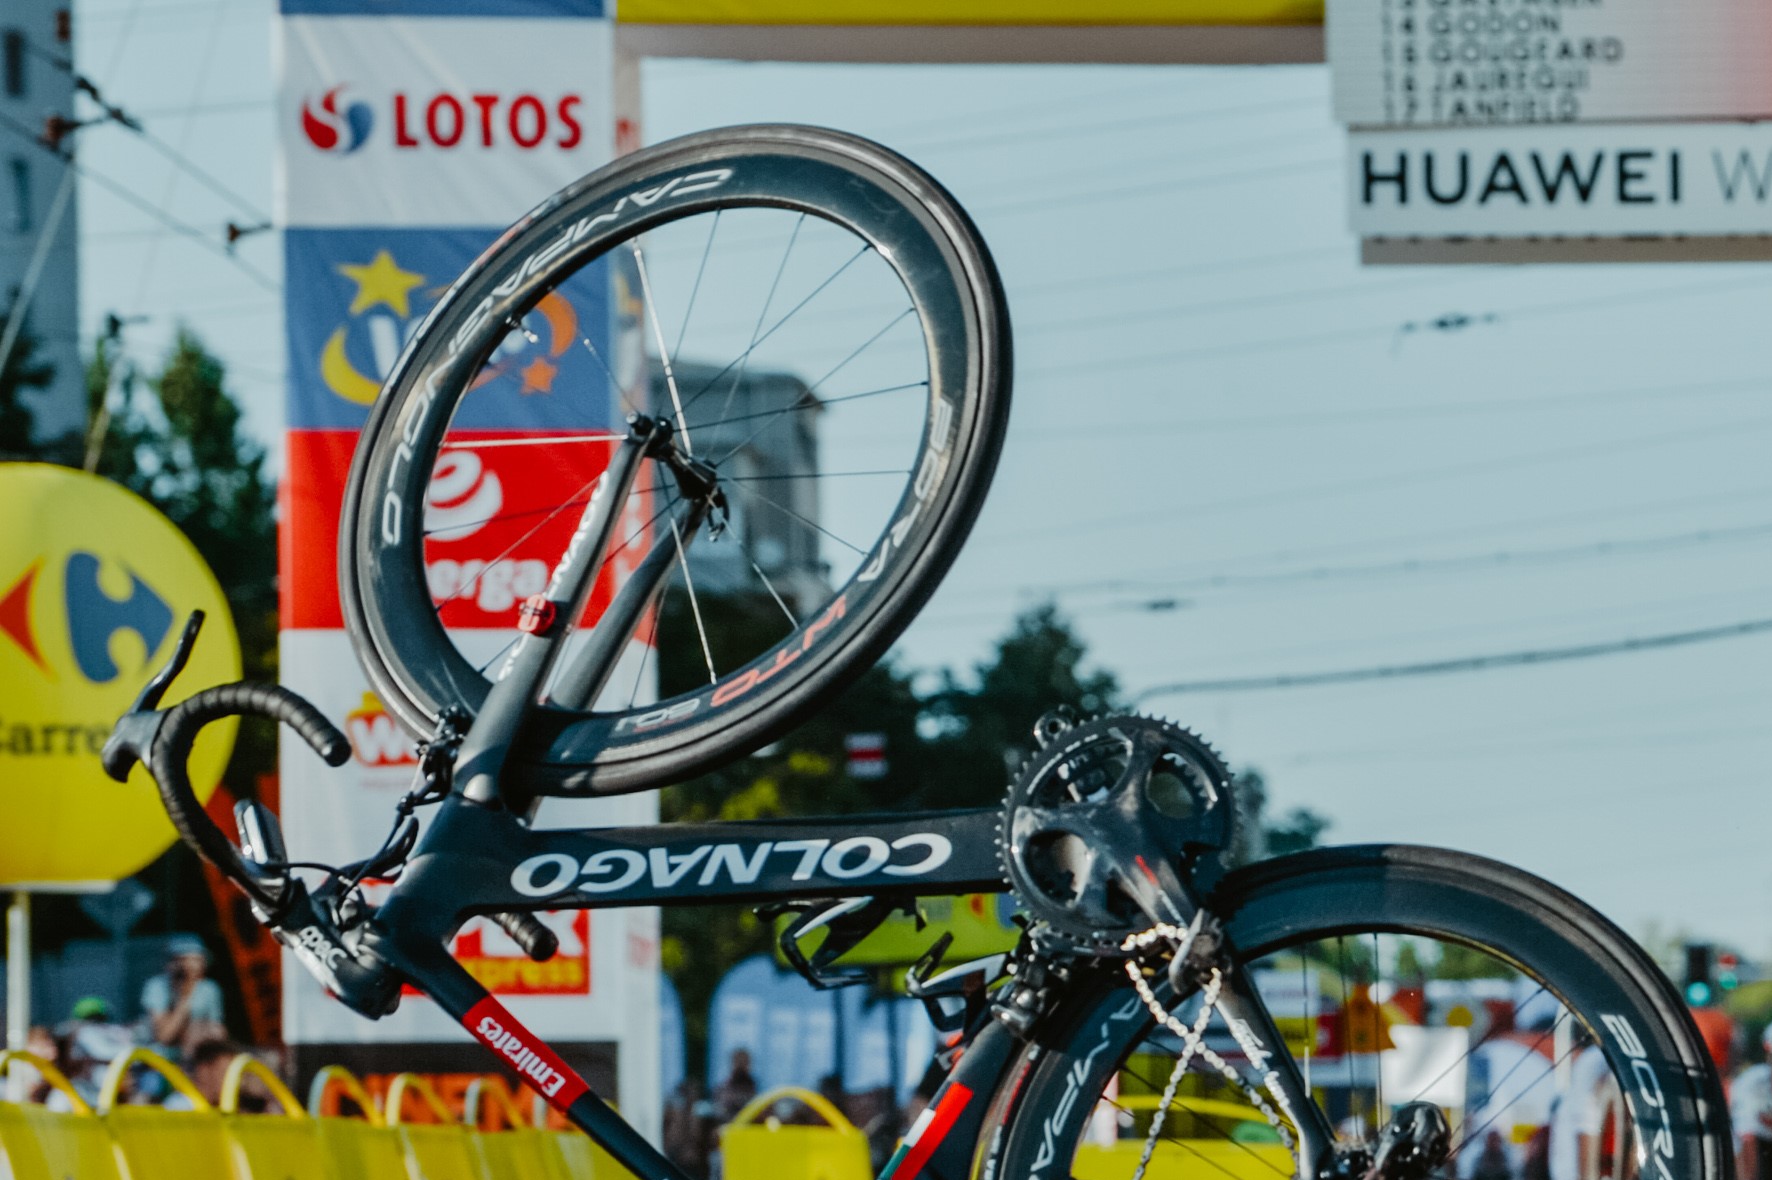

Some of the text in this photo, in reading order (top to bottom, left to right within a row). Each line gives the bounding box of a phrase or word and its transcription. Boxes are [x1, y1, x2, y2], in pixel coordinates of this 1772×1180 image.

[1428, 10, 1561, 34] GODON
[1428, 36, 1624, 64] GOUGEARD
[393, 93, 582, 149] LOTOS
[1361, 150, 1681, 204] HUAWEI
[510, 832, 953, 897] COLNAGO
[477, 1016, 566, 1098] Emirates
